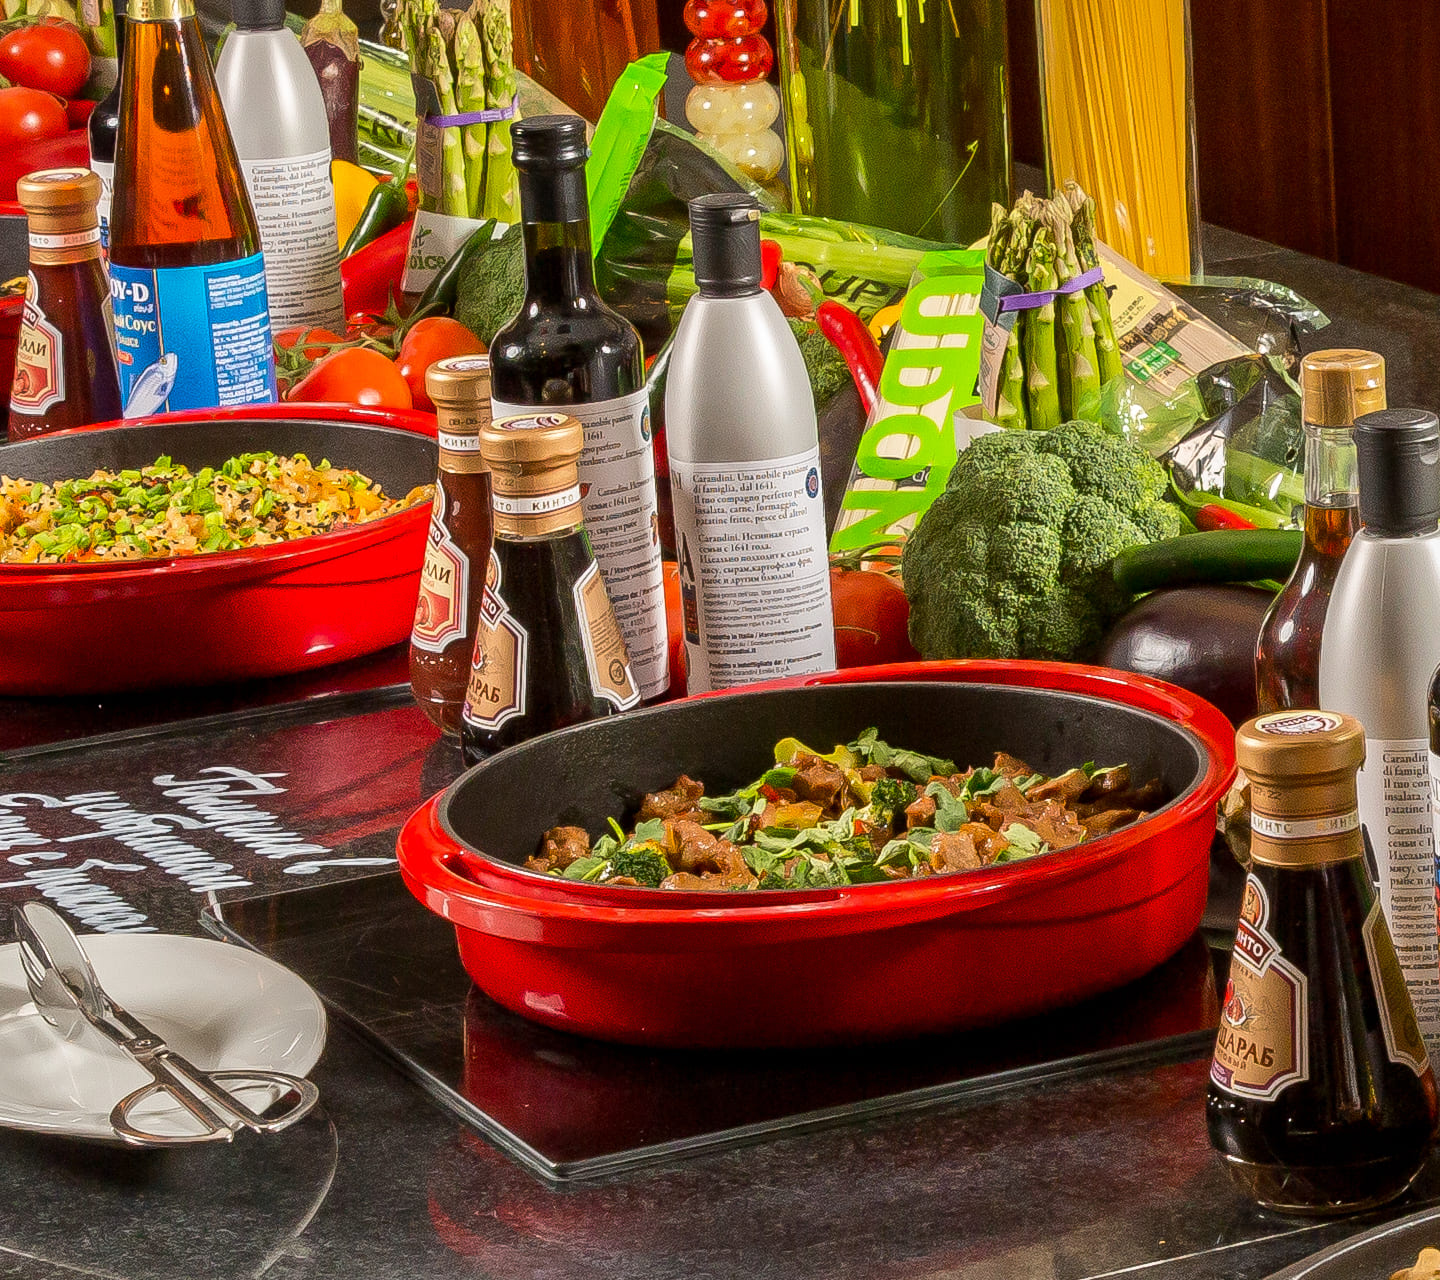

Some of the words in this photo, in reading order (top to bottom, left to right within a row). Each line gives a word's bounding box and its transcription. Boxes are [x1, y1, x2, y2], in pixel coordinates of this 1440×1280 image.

[111, 279, 149, 303] OY-D
[125, 315, 156, 335] Соус
[1132, 344, 1165, 370] Green
[829, 274, 986, 554] UDON
[443, 437, 479, 448] КИНТ
[693, 474, 735, 483] Carandini.
[737, 473, 754, 481] Una
[755, 471, 781, 480] nobile
[693, 485, 701, 494] di
[702, 483, 738, 494] famiglia,
[740, 483, 753, 492] dal
[755, 482, 776, 491] 1641.
[532, 494, 574, 511] КИНТО
[717, 495, 759, 505] compagno
[762, 490, 793, 503] perfetto
[729, 506, 755, 514] carne,
[756, 500, 798, 513] formaggio,
[695, 517, 728, 526] patatine
[729, 515, 754, 524] fritte,
[755, 515, 777, 523] pesce
[777, 511, 788, 520] ed
[698, 534, 741, 543] Carandini.
[742, 529, 783, 540] Истинная
[730, 543, 750, 552] 1641
[700, 554, 739, 563] Идеально
[741, 551, 780, 562] подходит
[729, 575, 759, 586] другим
[1385, 805, 1424, 816] patatine
[1236, 925, 1264, 958] НТО
